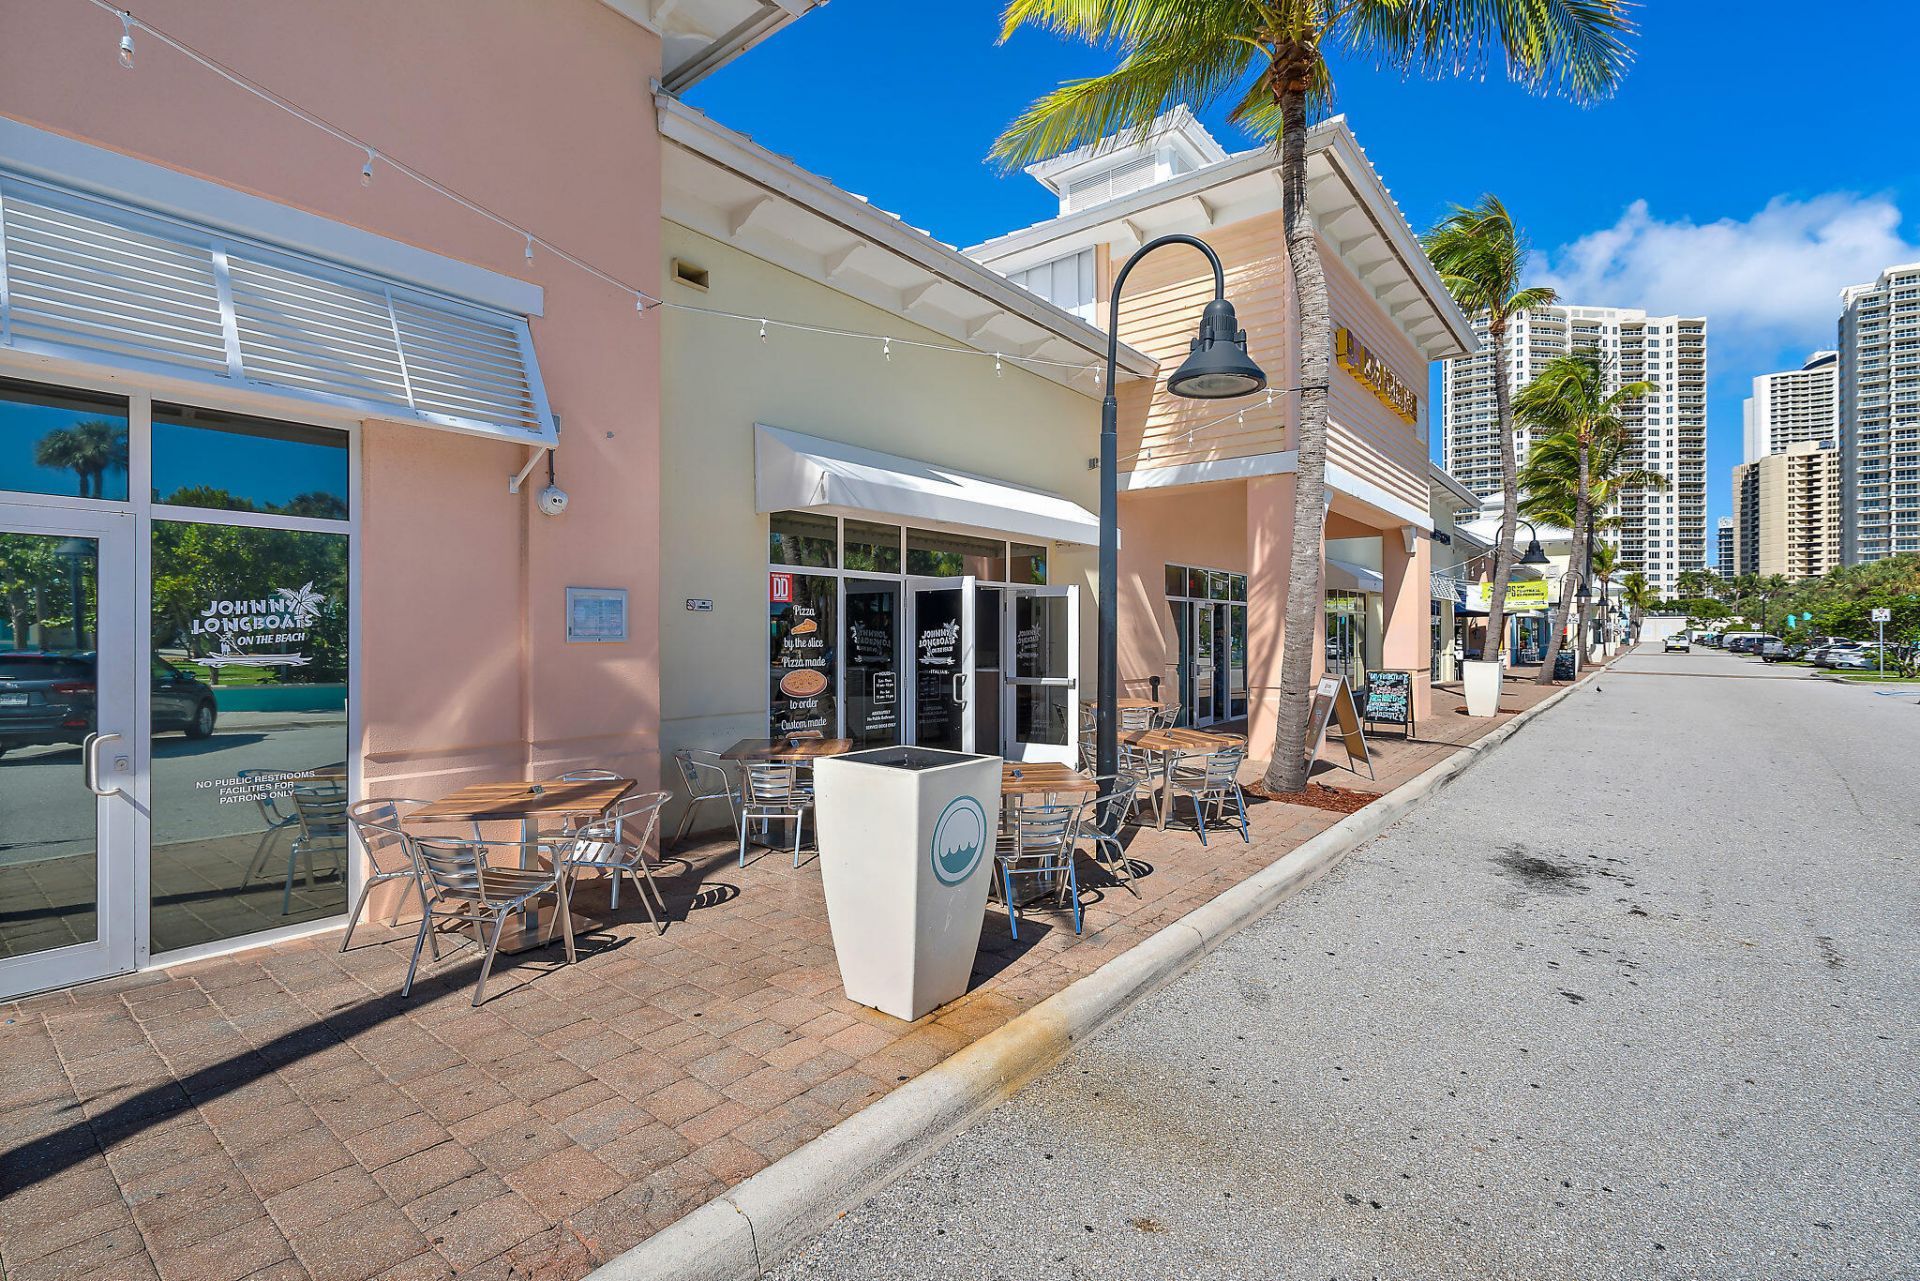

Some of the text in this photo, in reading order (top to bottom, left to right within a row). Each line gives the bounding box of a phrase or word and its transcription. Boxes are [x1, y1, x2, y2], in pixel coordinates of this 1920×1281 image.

[200, 598, 299, 617] JOHNNY
[792, 604, 816, 616] Pizza
[190, 613, 314, 635] LONGBOATS
[237, 632, 306, 646] ON THE BEACH
[921, 628, 951, 640] JOHNNY
[784, 637, 824, 650] by the slice
[782, 656, 826, 668] Pizza made
[789, 698, 819, 710] to order
[781, 716, 827, 730] Custom made
[196, 770, 316, 790] NO PUBLIC RESTROOMS
[219, 781, 294, 796] FACILITIES FOR
[219, 790, 294, 804] PATRONS ONLY
